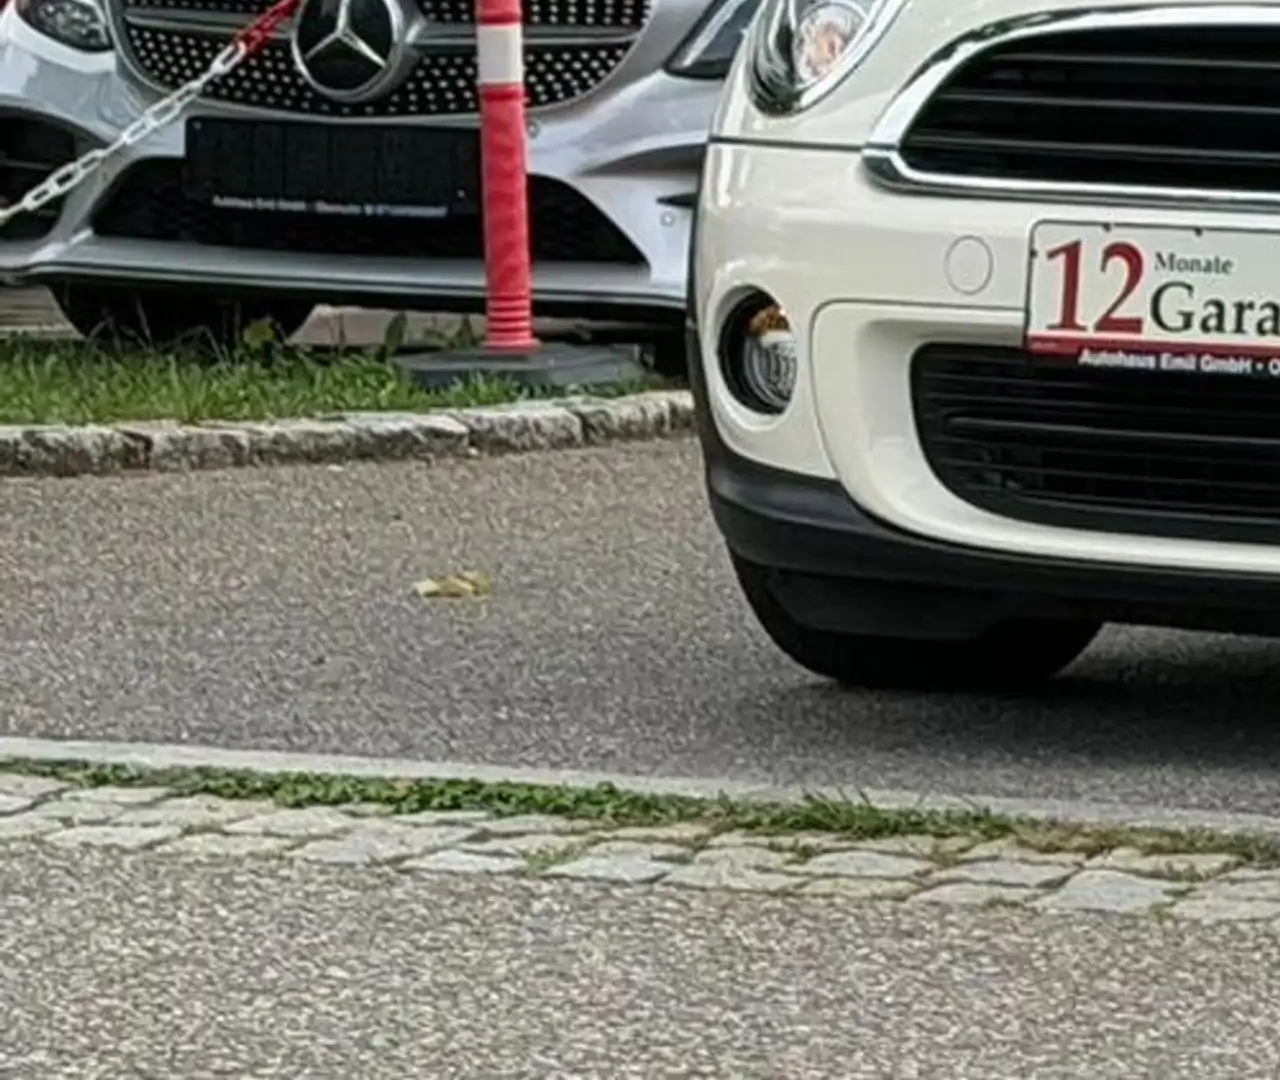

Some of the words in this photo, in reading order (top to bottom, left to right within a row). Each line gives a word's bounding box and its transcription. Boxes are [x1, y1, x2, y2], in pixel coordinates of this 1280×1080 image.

[1154, 251, 1234, 276] Monate
[1046, 239, 1145, 334] 12
[1078, 348, 1157, 371] Autohaus
[1159, 351, 1197, 371] Emil
[1200, 353, 1253, 375] GmbH
